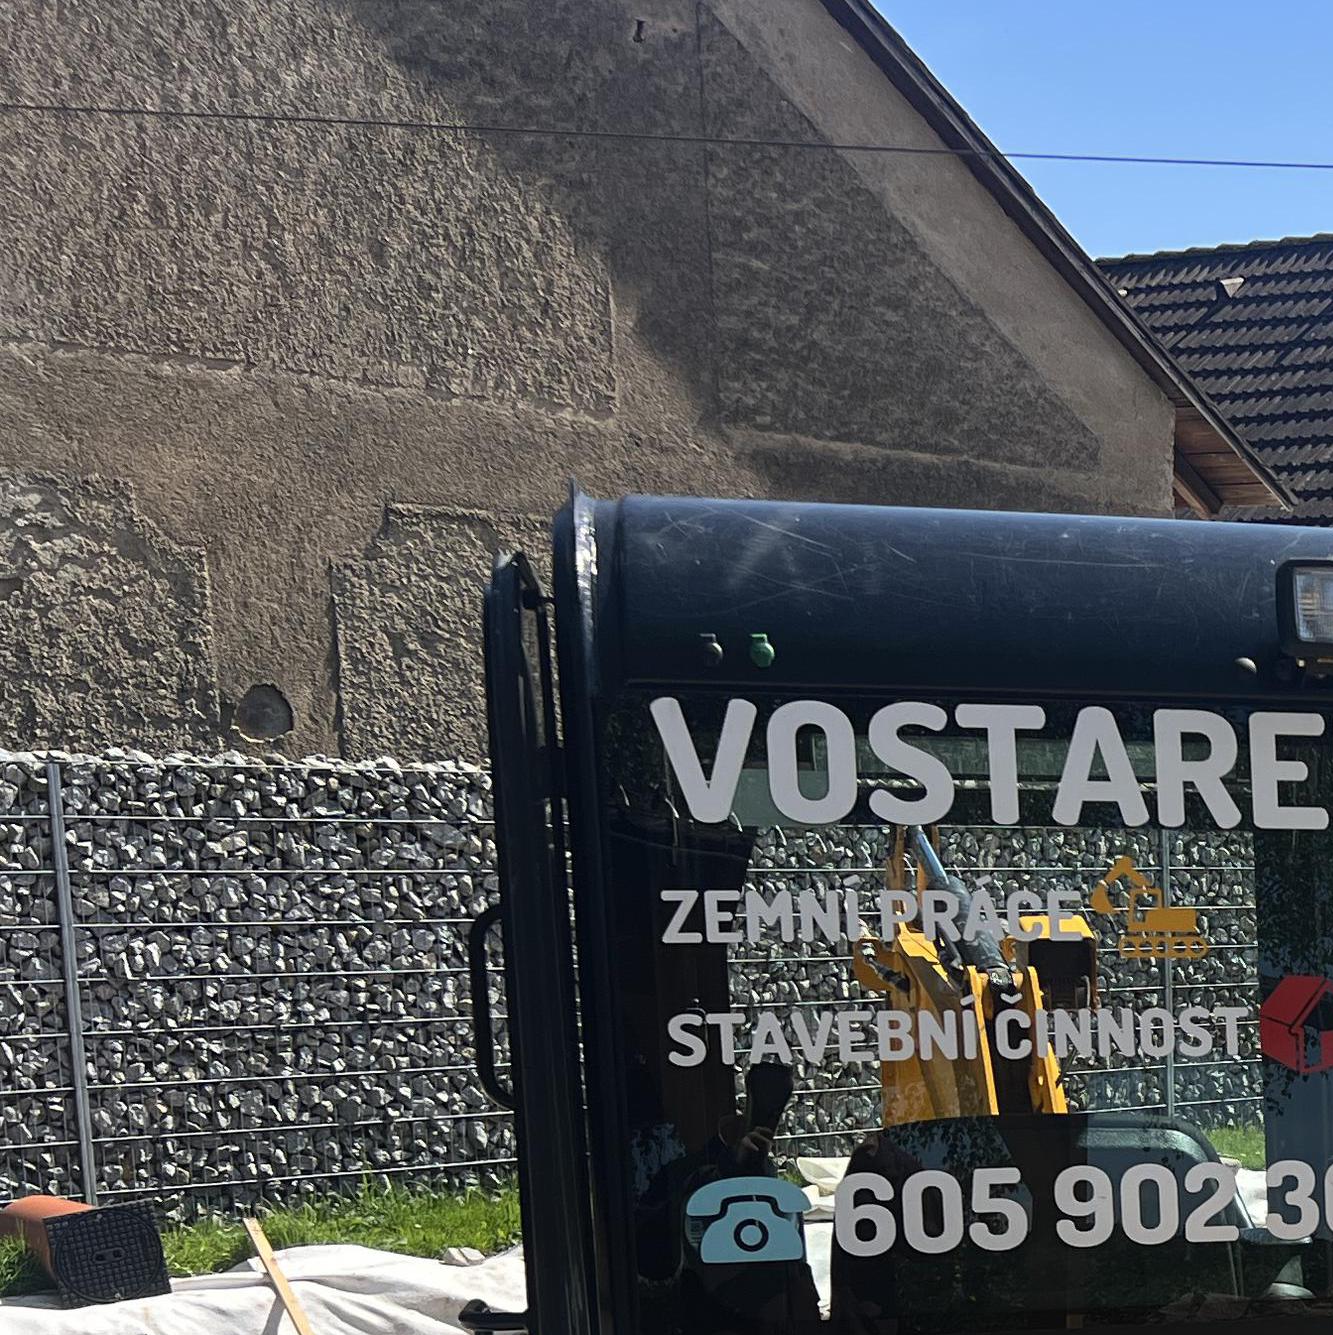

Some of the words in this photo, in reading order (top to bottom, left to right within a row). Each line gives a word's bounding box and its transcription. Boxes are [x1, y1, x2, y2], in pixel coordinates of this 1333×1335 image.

[660, 875, 862, 944] ZEMNÍ
[880, 875, 1083, 942] PRÁCE
[668, 995, 977, 1067] STAVEBNÍ
[995, 993, 1249, 1060] ČINNOST
[834, 1167, 1028, 1257] 605
[1054, 1162, 1239, 1248] 902
